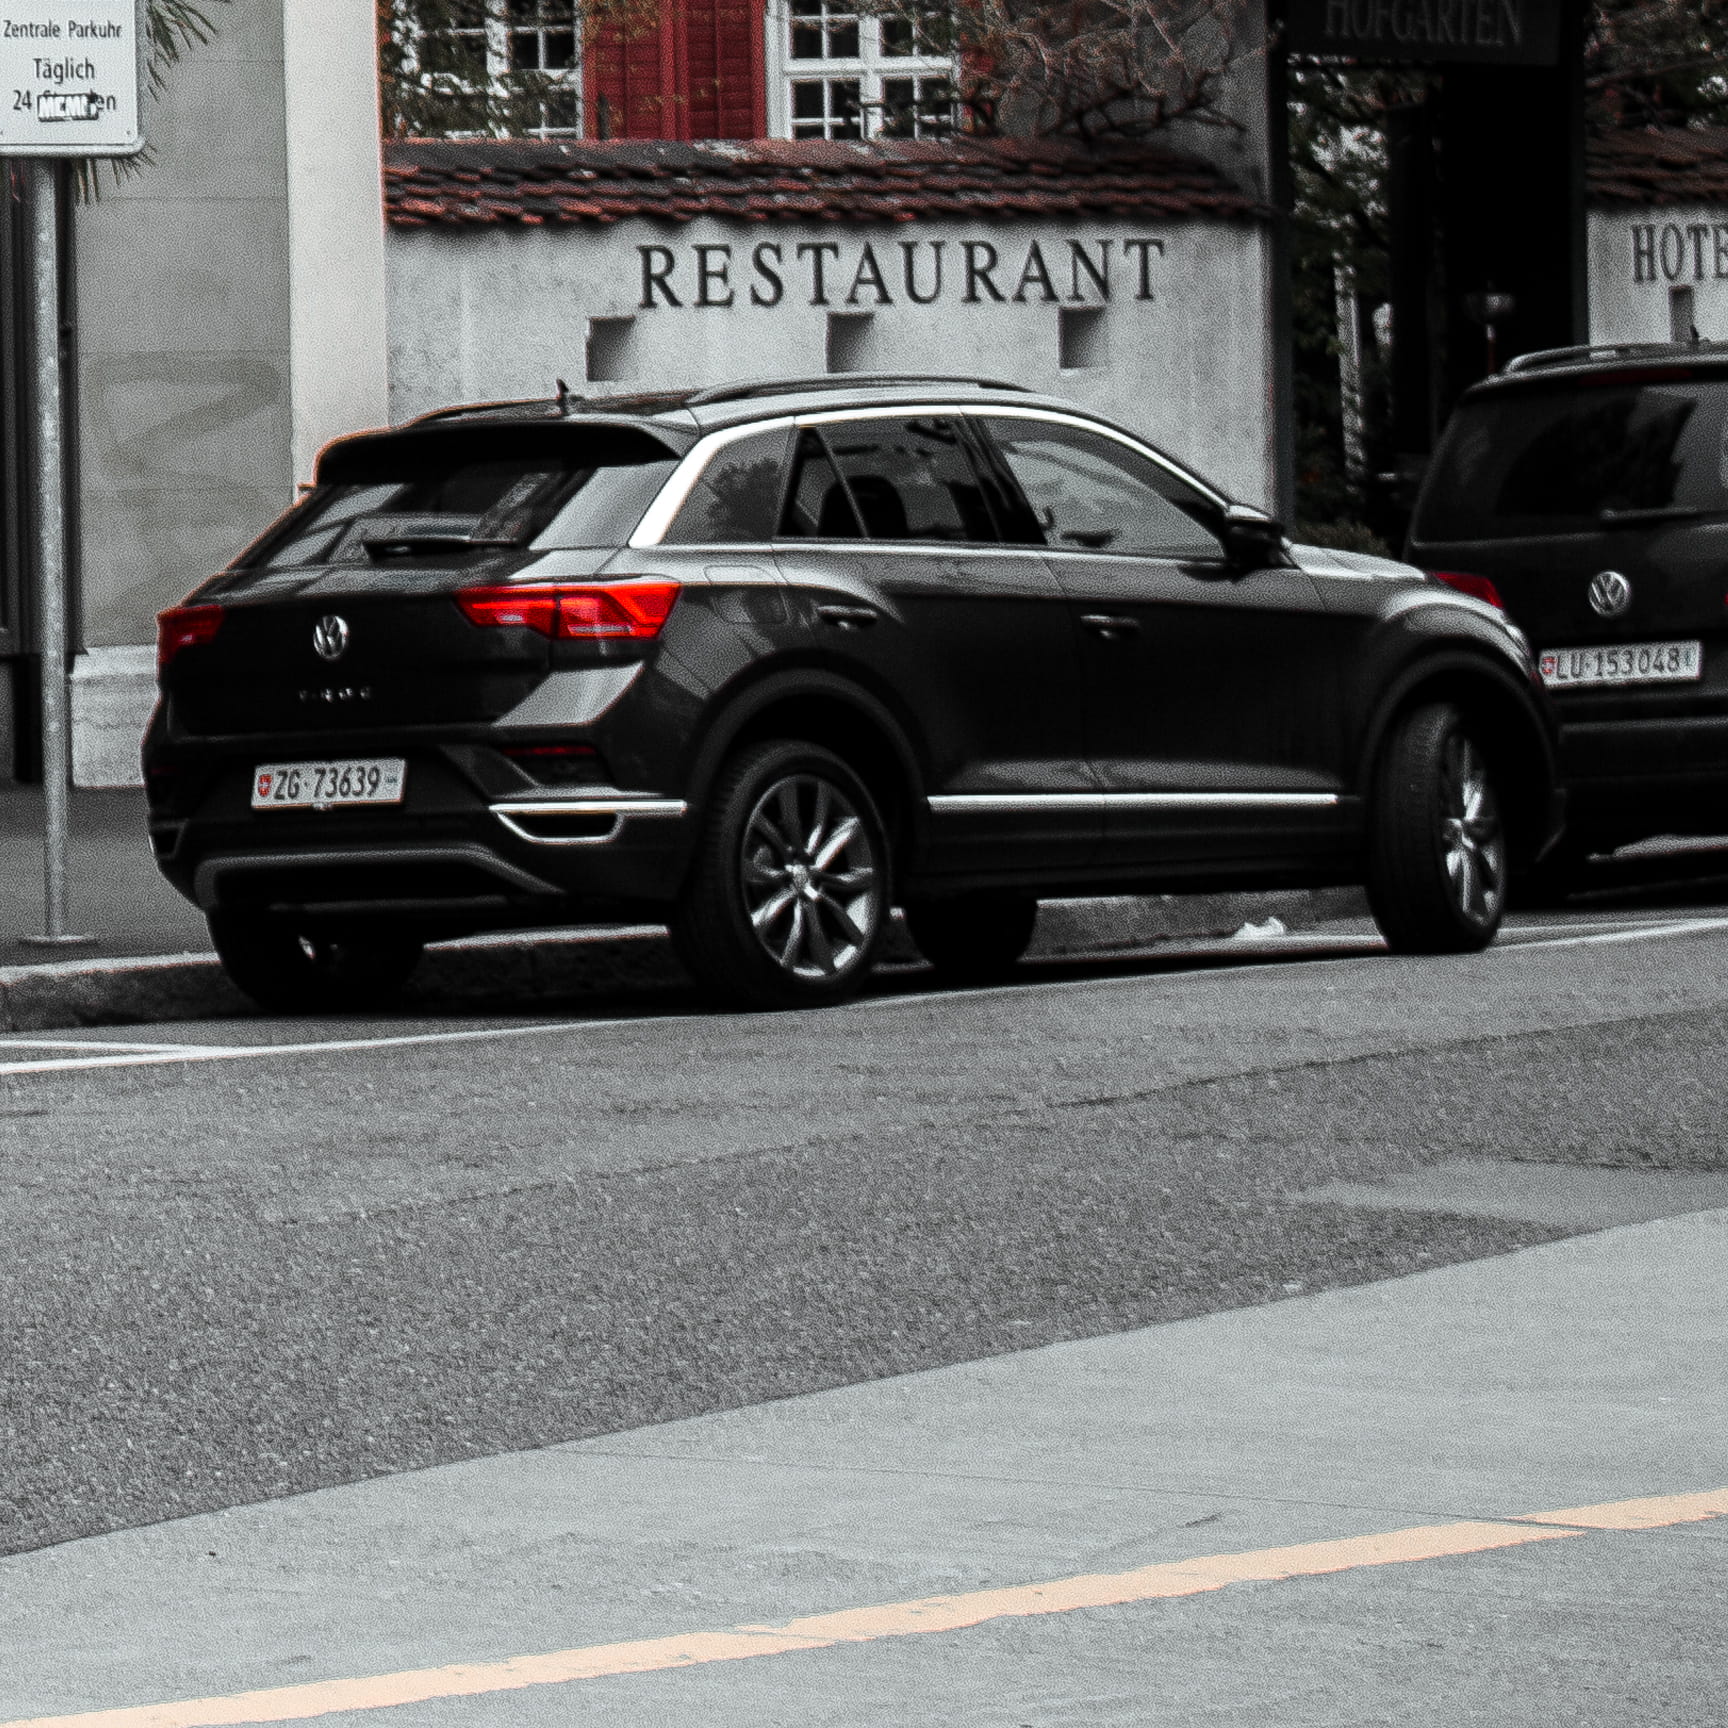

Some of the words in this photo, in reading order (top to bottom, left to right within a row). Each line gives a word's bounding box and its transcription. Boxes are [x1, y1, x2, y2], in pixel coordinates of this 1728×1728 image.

[3, 19, 61, 38] Zentrale
[68, 19, 122, 38] Parkuhr
[33, 57, 95, 84] Täglich
[13, 90, 32, 111] 24
[638, 238, 1165, 307] RESTAURANT
